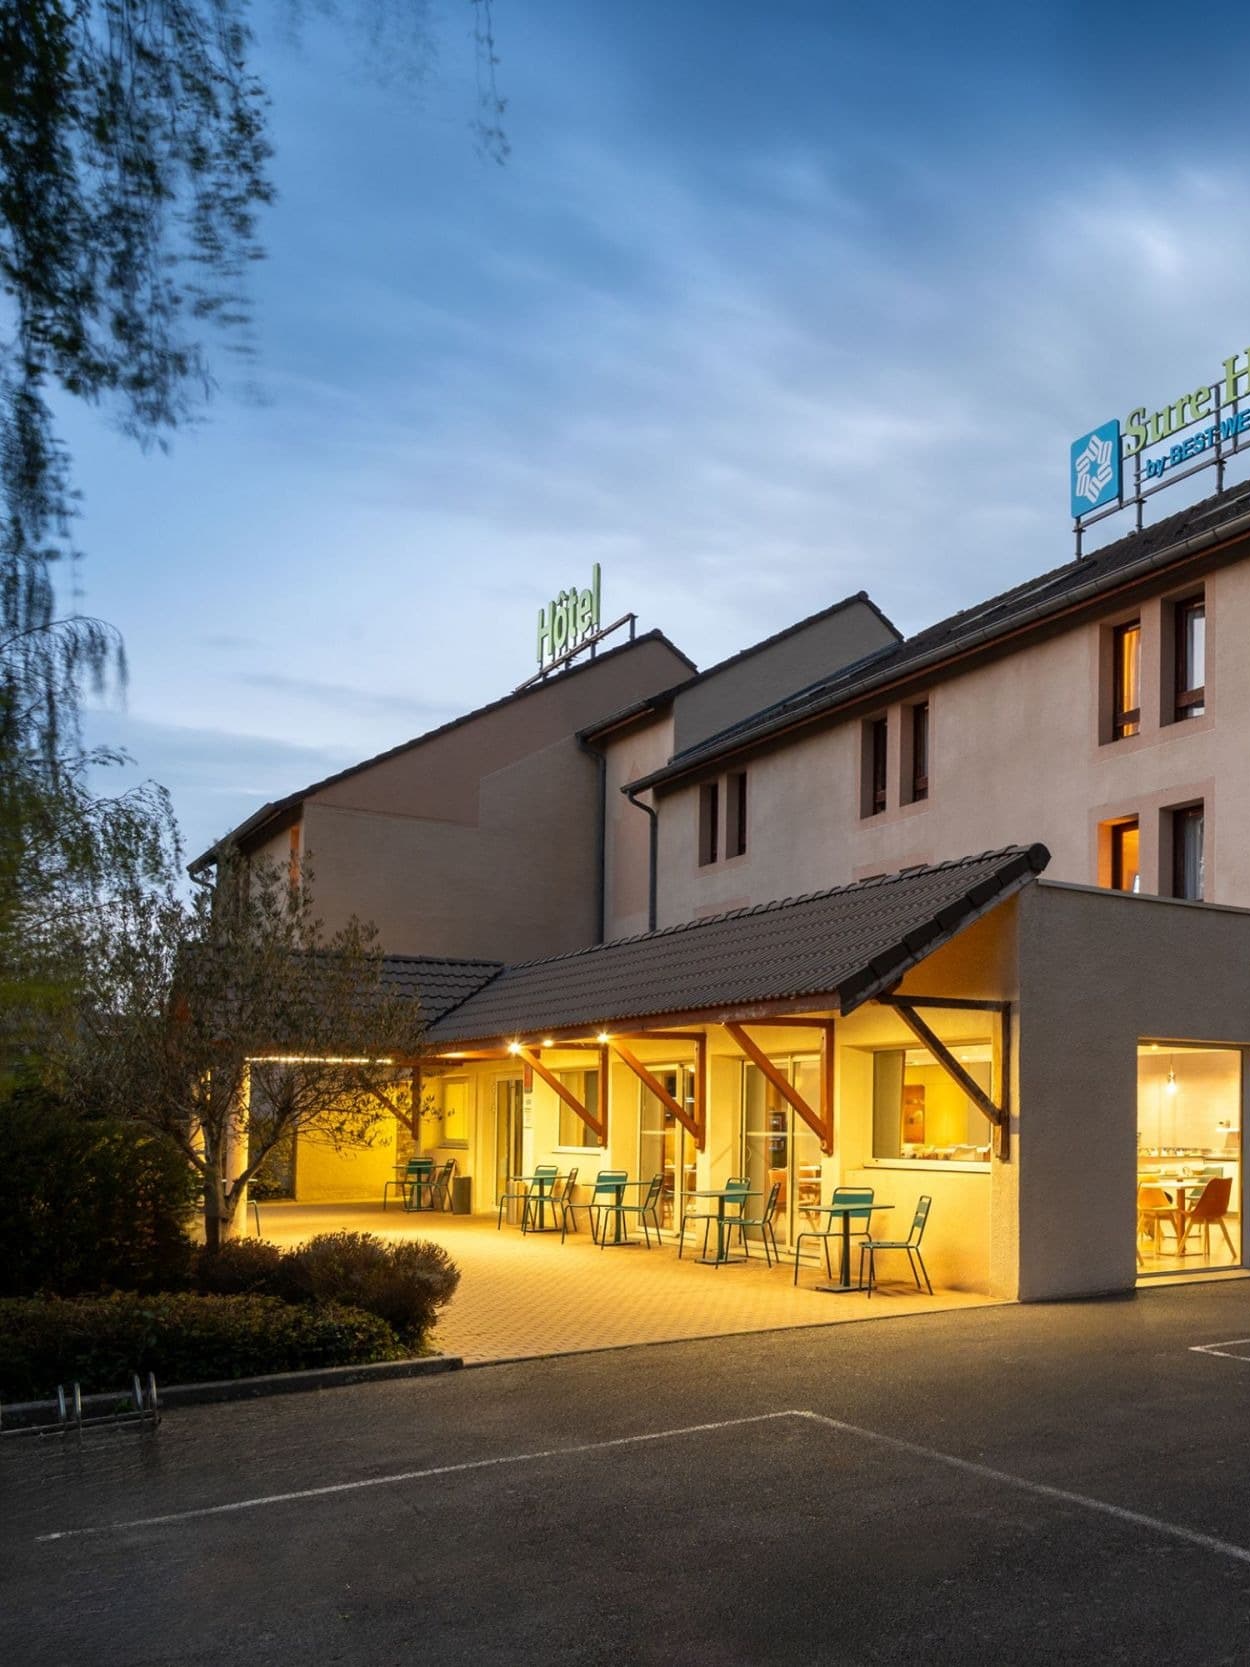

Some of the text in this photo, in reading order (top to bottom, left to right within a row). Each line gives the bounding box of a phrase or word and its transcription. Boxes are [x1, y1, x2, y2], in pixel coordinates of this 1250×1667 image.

[1123, 386, 1211, 456] Sure
[1146, 458, 1166, 478] by
[1169, 426, 1216, 465] BEST
[537, 563, 601, 662] Hôtel
